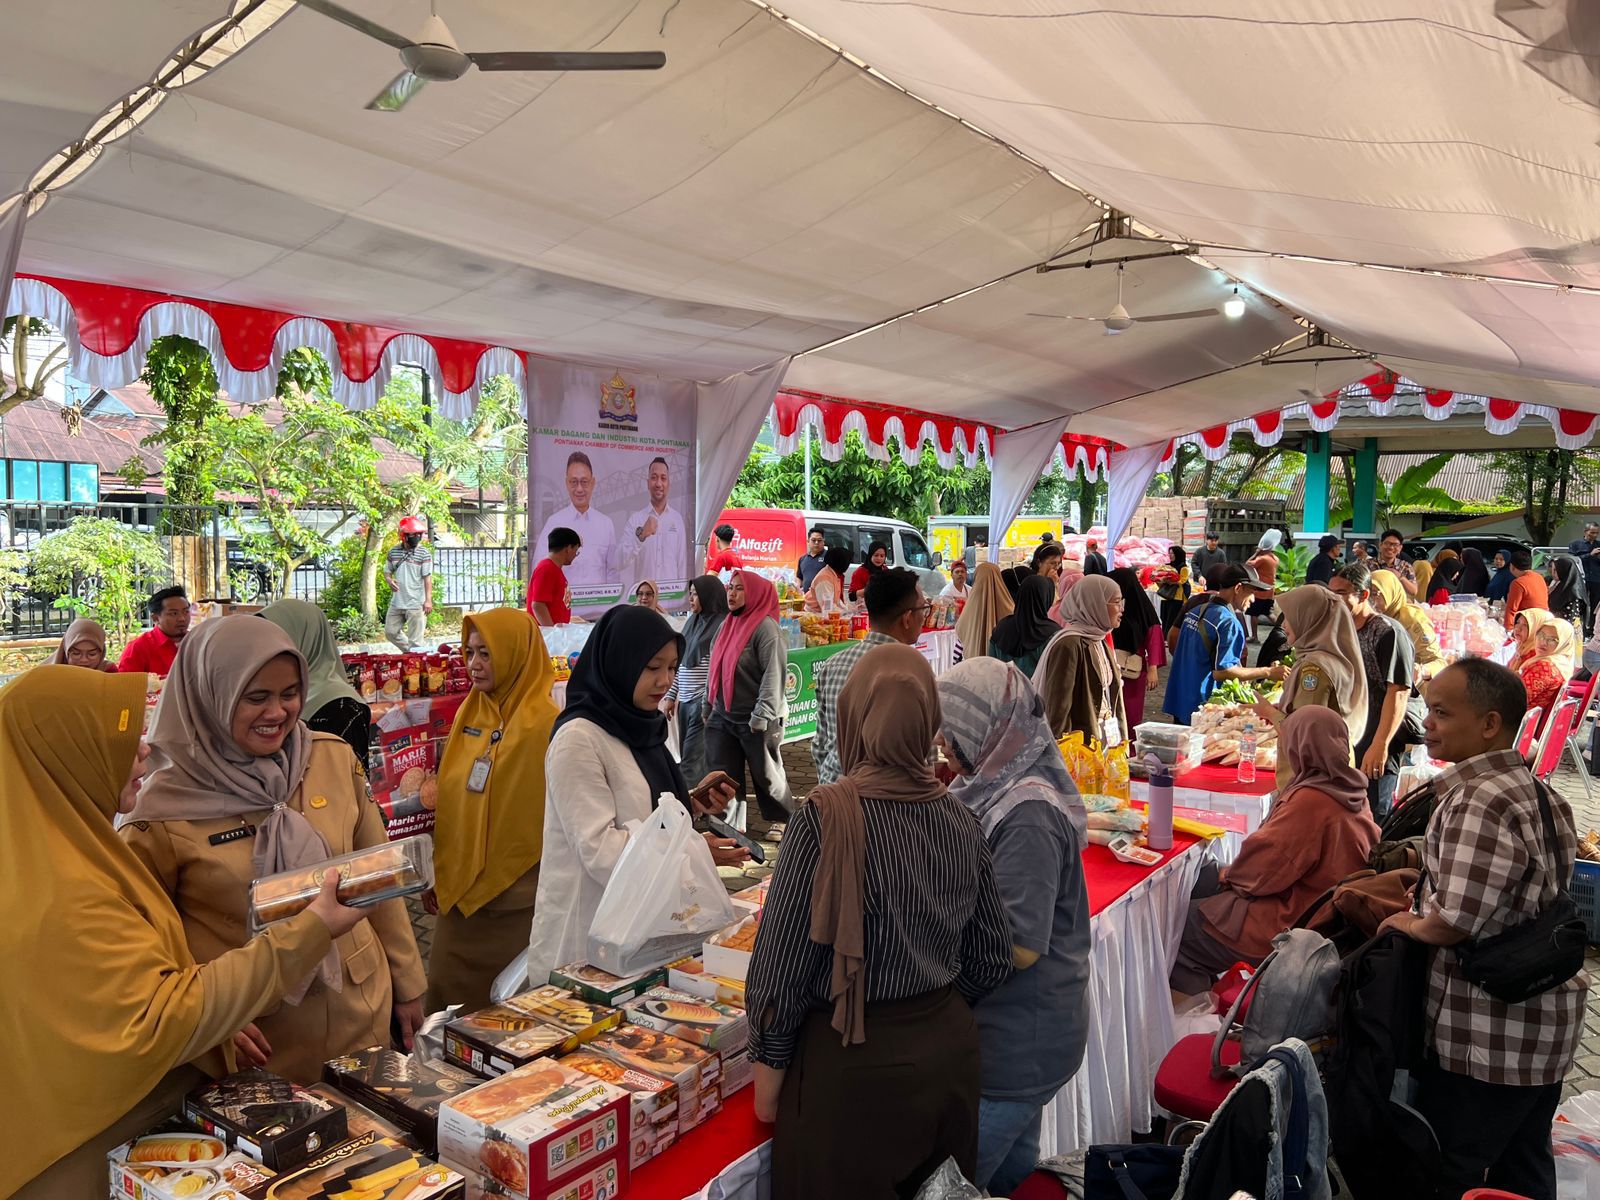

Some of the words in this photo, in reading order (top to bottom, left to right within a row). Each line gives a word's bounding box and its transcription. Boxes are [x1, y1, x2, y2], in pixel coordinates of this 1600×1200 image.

[532, 427, 559, 436] KAMAR
[561, 430, 590, 438] DAGANG
[607, 434, 637, 442] INDUSTRI
[640, 436, 656, 444] KOTA
[657, 439, 690, 448] PONTIANAK
[554, 438, 584, 446] PONTIANAK
[585, 441, 609, 449] CHAMBER
[739, 538, 783, 552] Alfagift
[392, 746, 426, 767] MARIE
[393, 755, 427, 774] BISCUITS
[388, 815, 415, 828] Marie
[416, 811, 435, 821] Favo
[308, 1131, 376, 1168] Mandarin
